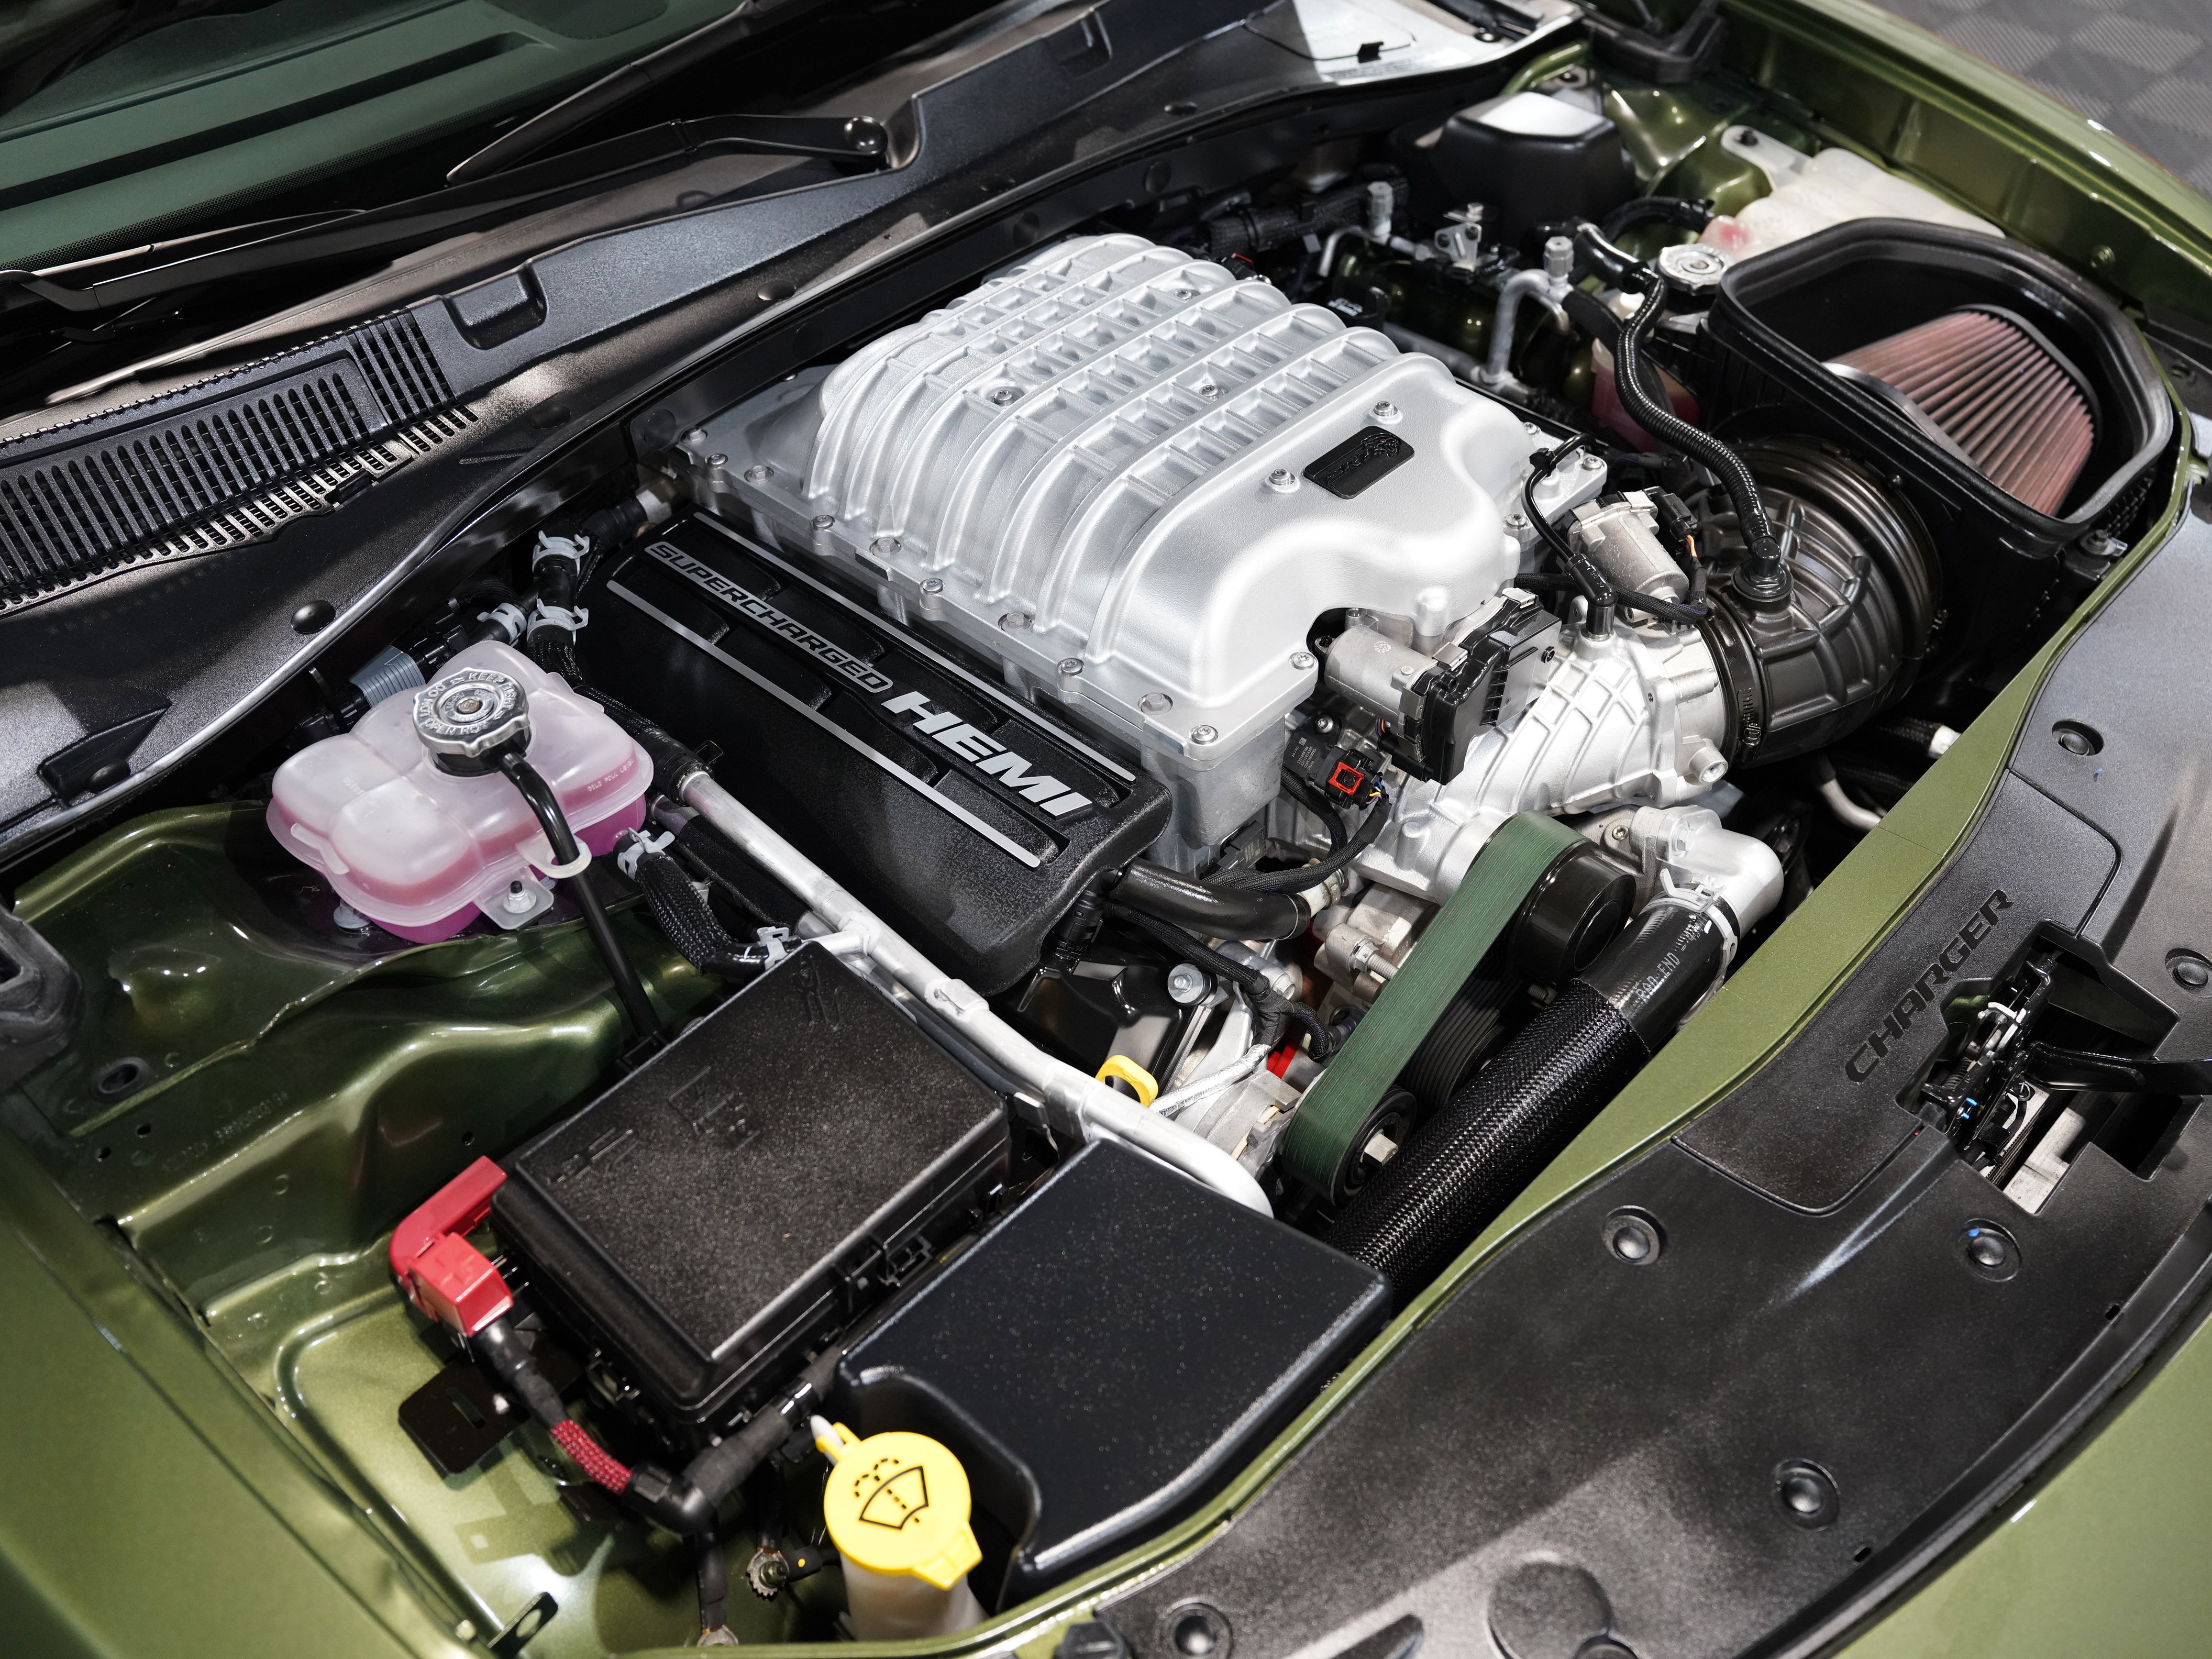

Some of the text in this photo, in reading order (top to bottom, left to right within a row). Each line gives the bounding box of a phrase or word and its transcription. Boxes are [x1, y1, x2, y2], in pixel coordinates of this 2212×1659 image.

[428, 684, 446, 698] DO
[468, 672, 505, 683] KEEP
[503, 682, 517, 711] TIGHT
[650, 544, 1093, 821] SUPERCHARGED HEMI
[419, 698, 434, 717] NOT
[425, 718, 456, 735] OPEN
[460, 721, 491, 734] HOT
[1291, 746, 1299, 758] 20/20
[1304, 748, 1317, 768] CONTINENTAL
[1656, 952, 1680, 978] END
[1845, 889, 2014, 1083] CHARGER
